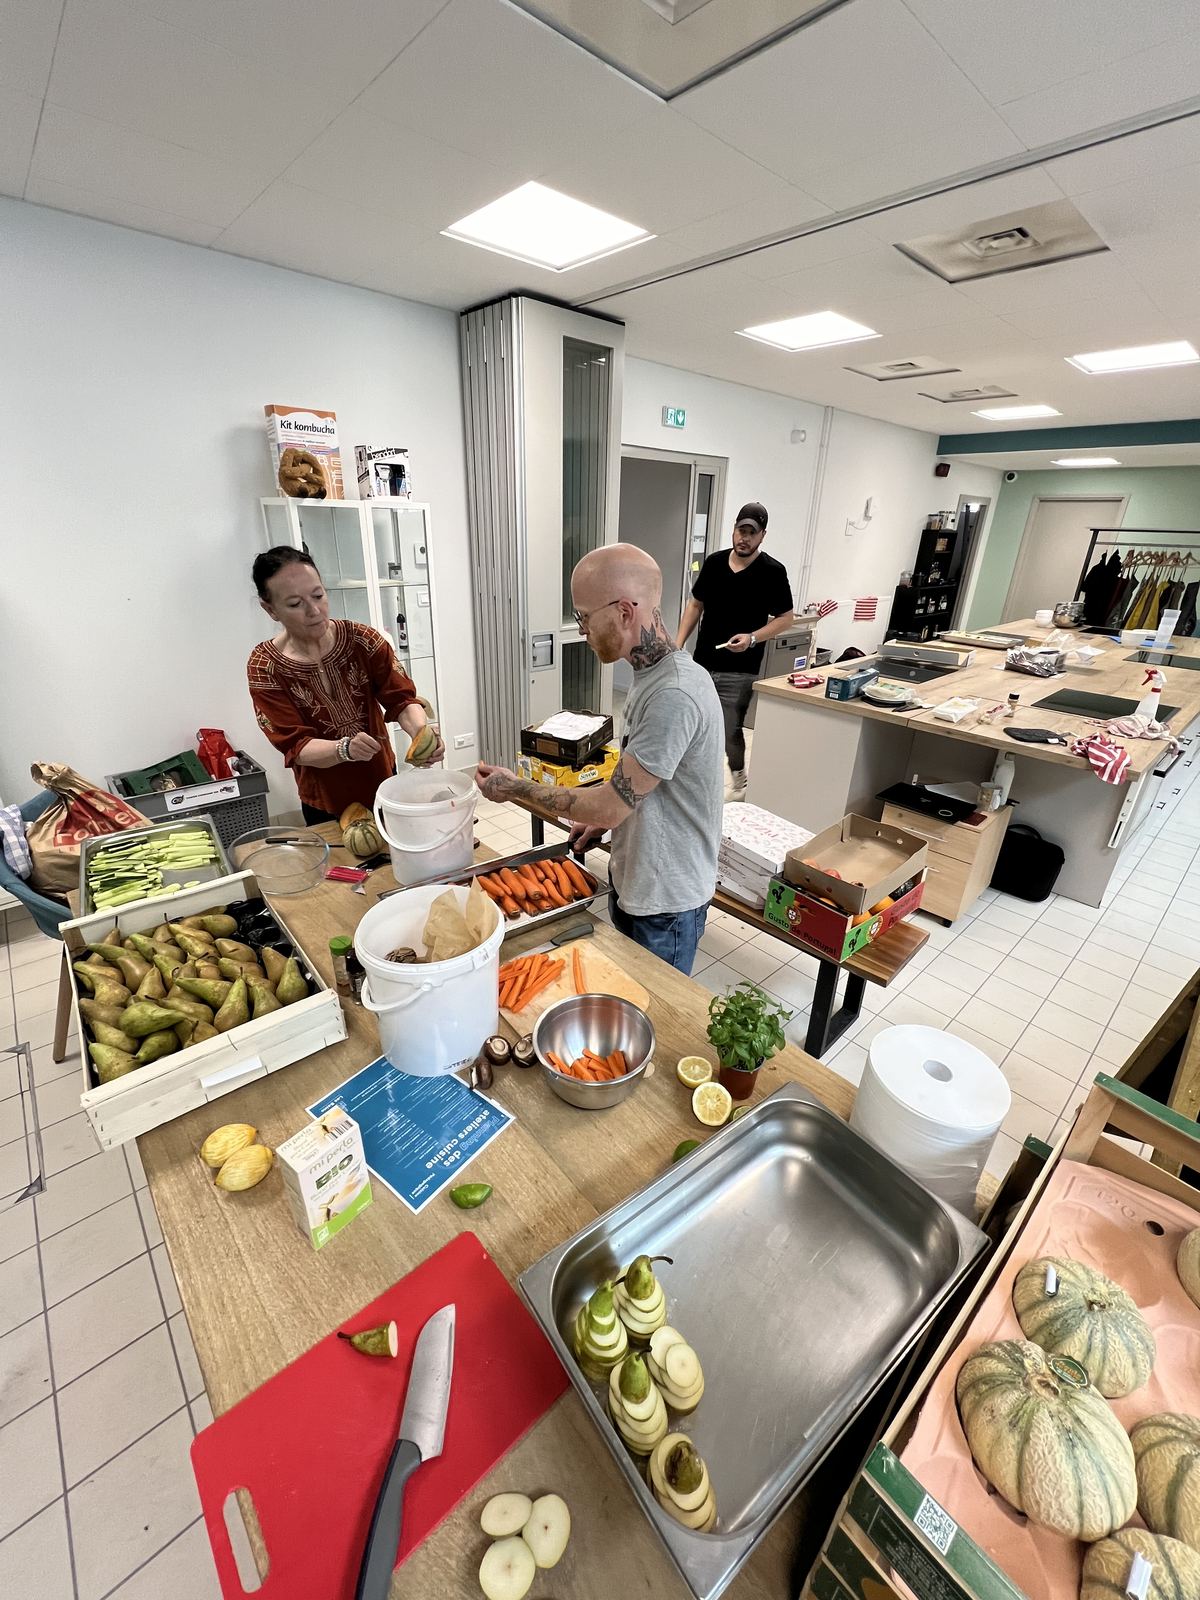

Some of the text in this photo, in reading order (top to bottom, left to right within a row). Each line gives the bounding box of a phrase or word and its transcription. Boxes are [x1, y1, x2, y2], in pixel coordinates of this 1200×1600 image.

[280, 420, 292, 430] Kit
[294, 420, 335, 435] kombucha
[768, 912, 790, 929] Gusto
[803, 932, 837, 956] Portugal
[457, 1109, 490, 1139] ateliers
[425, 1138, 459, 1169] cuisine
[443, 1150, 461, 1167] des
[309, 1158, 324, 1174] mi
